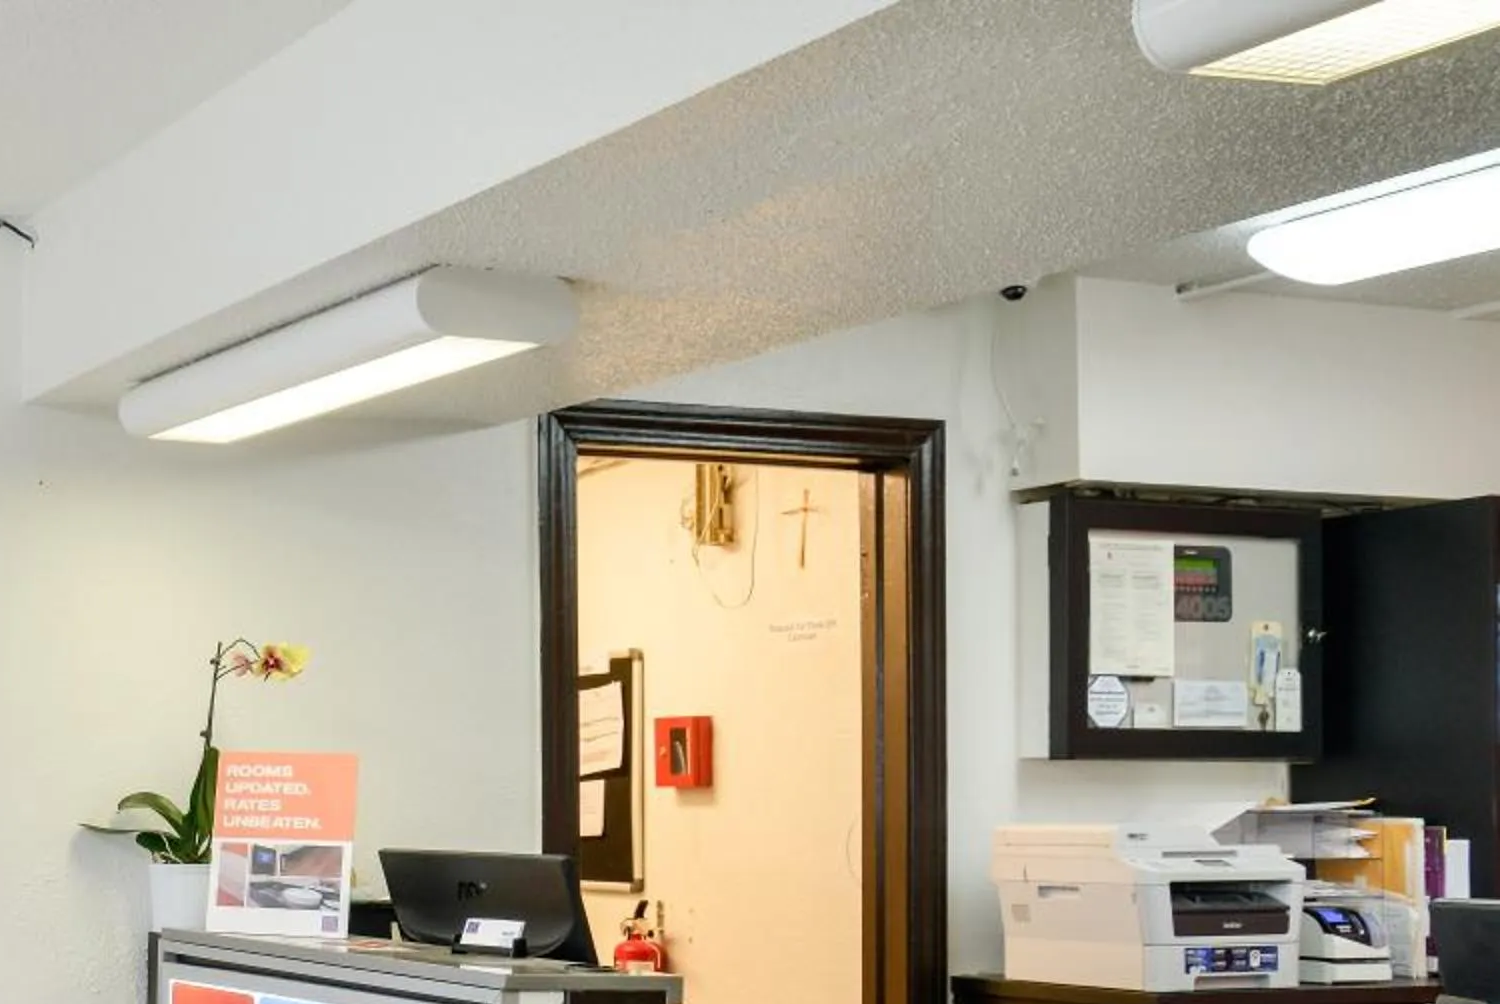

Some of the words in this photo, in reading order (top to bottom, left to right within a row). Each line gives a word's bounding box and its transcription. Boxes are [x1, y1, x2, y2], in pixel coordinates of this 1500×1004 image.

[227, 765, 293, 777] ROOMS
[225, 782, 312, 795] UPDATED.
[224, 798, 281, 811] RATES
[223, 815, 322, 830] UNBEATEN.
